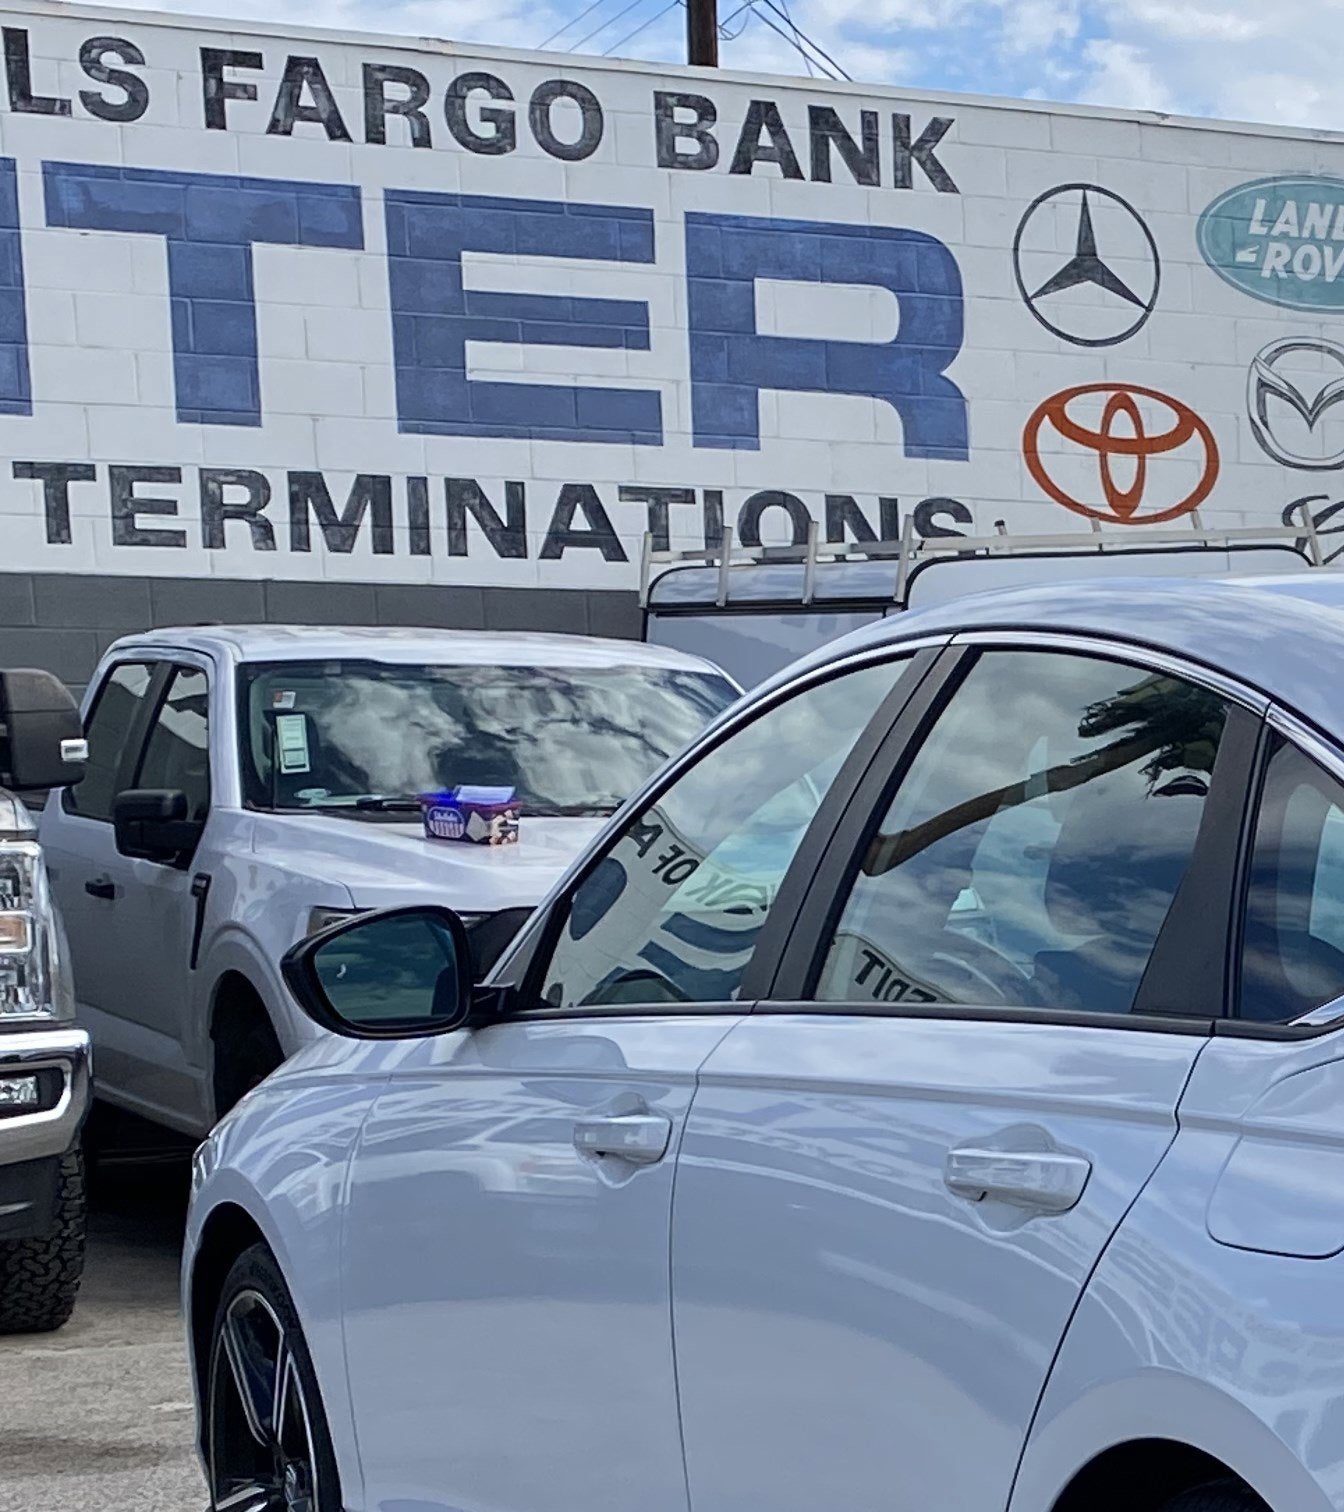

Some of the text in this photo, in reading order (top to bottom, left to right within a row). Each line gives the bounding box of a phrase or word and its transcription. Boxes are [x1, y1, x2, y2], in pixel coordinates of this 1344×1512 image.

[200, 47, 603, 161] FARGO
[652, 91, 960, 194] BANK
[0, 157, 969, 461] TER
[12, 460, 974, 565] TERMINATIONS
